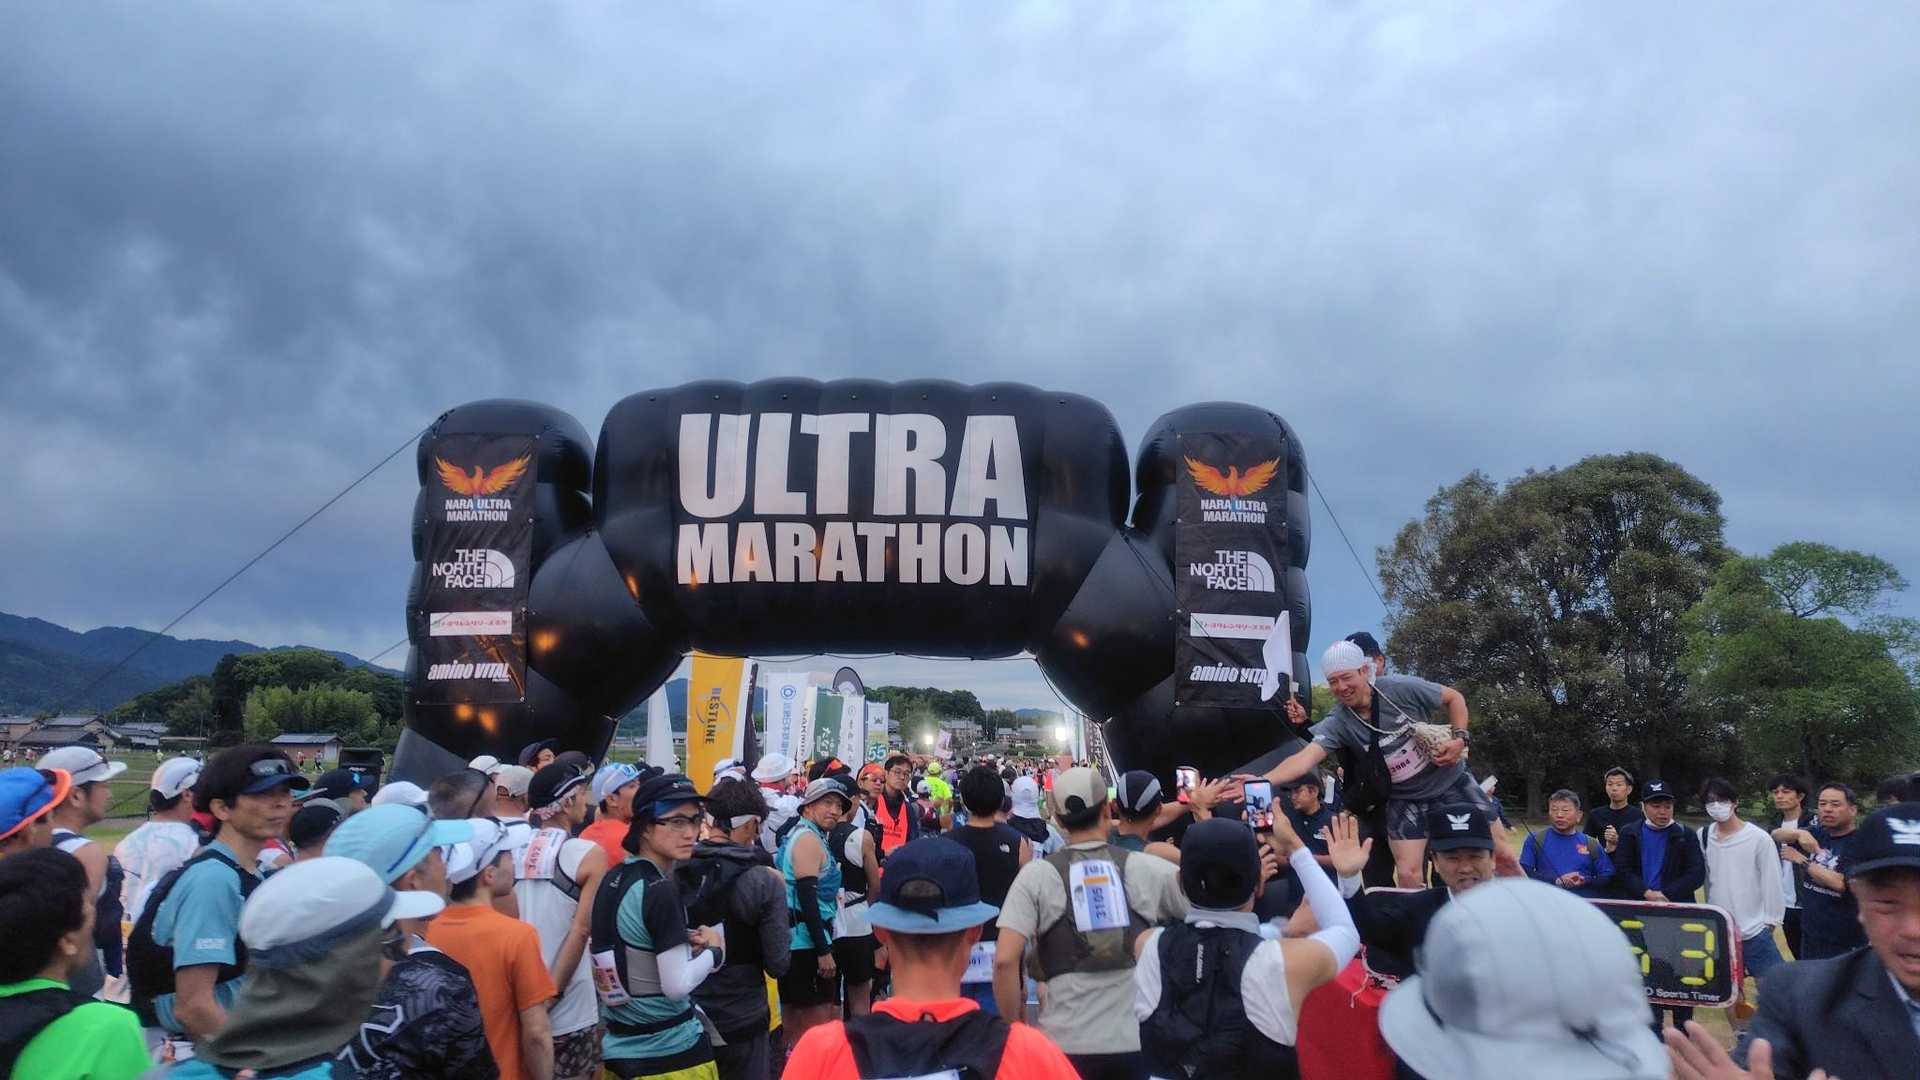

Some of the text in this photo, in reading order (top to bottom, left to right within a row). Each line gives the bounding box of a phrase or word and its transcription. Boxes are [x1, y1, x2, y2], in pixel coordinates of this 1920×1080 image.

[678, 412, 1029, 520] ULTRA
[445, 499, 512, 510] NARA ULTRA
[1200, 499, 1268, 513] NARA ULTRA
[446, 510, 508, 522] MARATHON
[1203, 510, 1265, 524] MARATHON
[455, 549, 485, 562] THE
[677, 521, 1029, 586] MARATHON
[1215, 550, 1247, 564] THE
[432, 562, 485, 576] NORTH
[1190, 563, 1248, 577] NORTH
[444, 574, 484, 588] FACE
[1206, 576, 1247, 590] FACE
[427, 660, 510, 680] amino VITAL
[1190, 662, 1239, 682] amino
[1092, 887, 1107, 920] 3105
[1655, 987, 1689, 1000] Sports
[1691, 991, 1720, 1002] Timer
